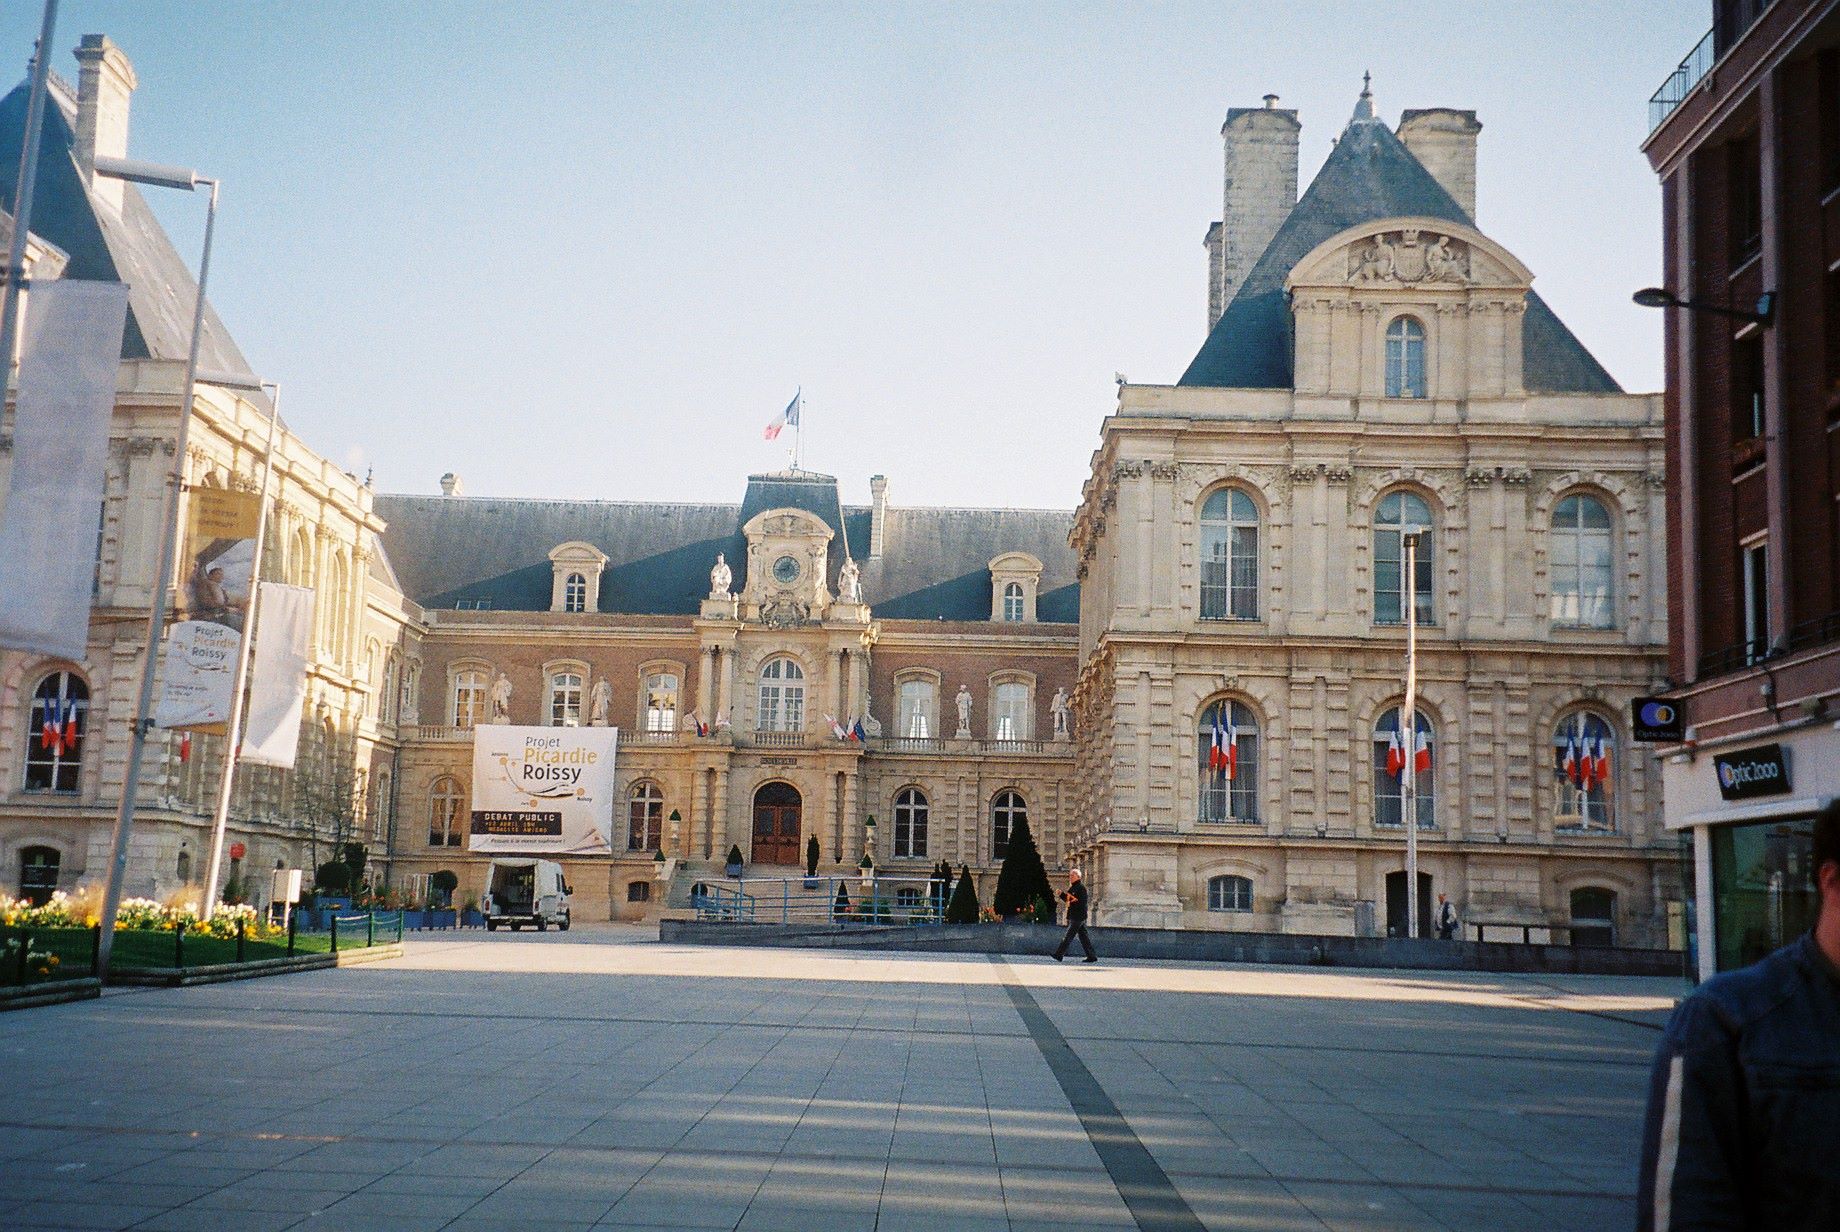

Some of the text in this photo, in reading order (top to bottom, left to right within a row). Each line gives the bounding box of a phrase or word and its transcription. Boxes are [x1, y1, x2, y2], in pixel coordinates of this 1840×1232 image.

[192, 647, 227, 660] Roissy
[525, 736, 560, 749] Projet
[524, 747, 598, 764] Picardie
[523, 763, 582, 784] Roissy
[484, 813, 555, 822] DEBAT PUBLIC
